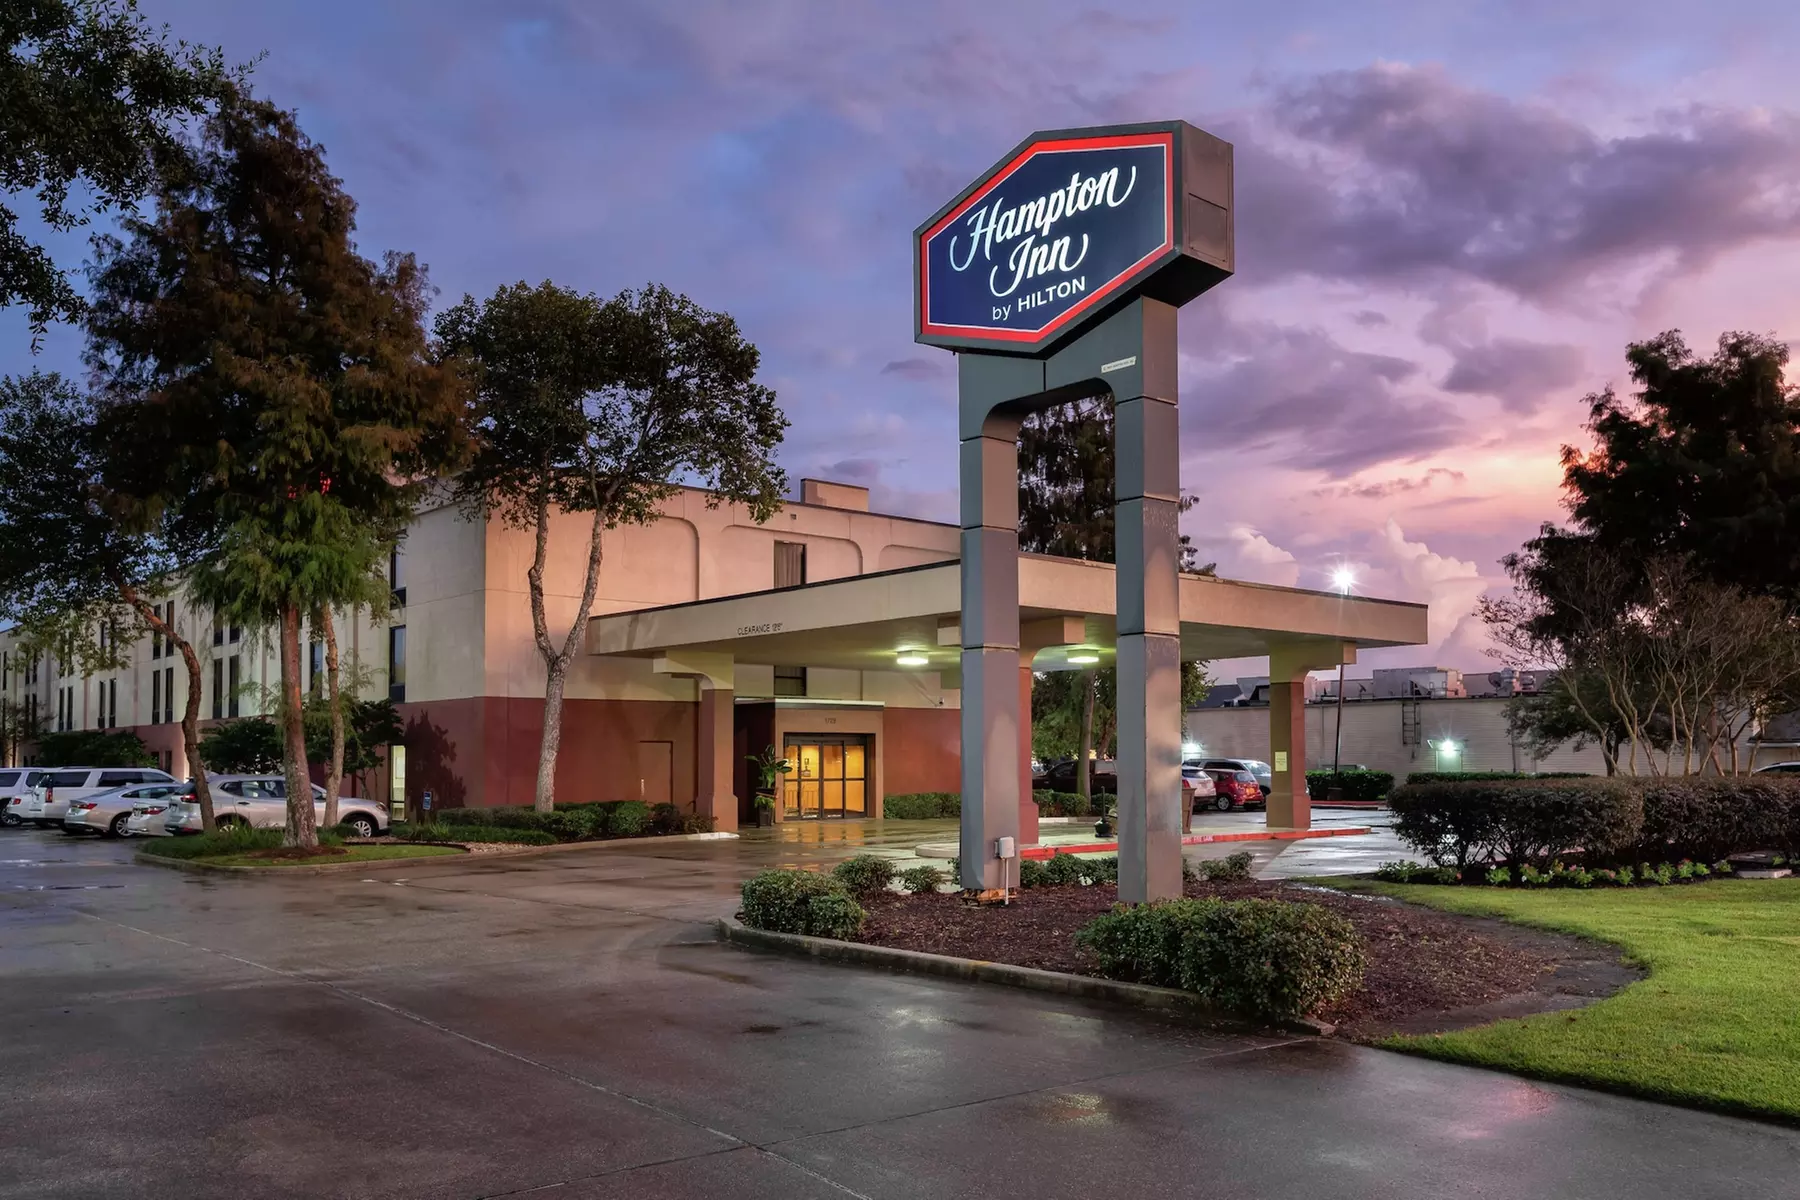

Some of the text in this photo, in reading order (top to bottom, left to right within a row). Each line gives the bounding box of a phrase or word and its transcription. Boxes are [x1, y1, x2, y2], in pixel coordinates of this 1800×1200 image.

[950, 165, 1136, 271] Hampton
[989, 233, 1089, 297] Inn
[992, 275, 1086, 321] by HILTON
[738, 624, 770, 635] CLEARANCE
